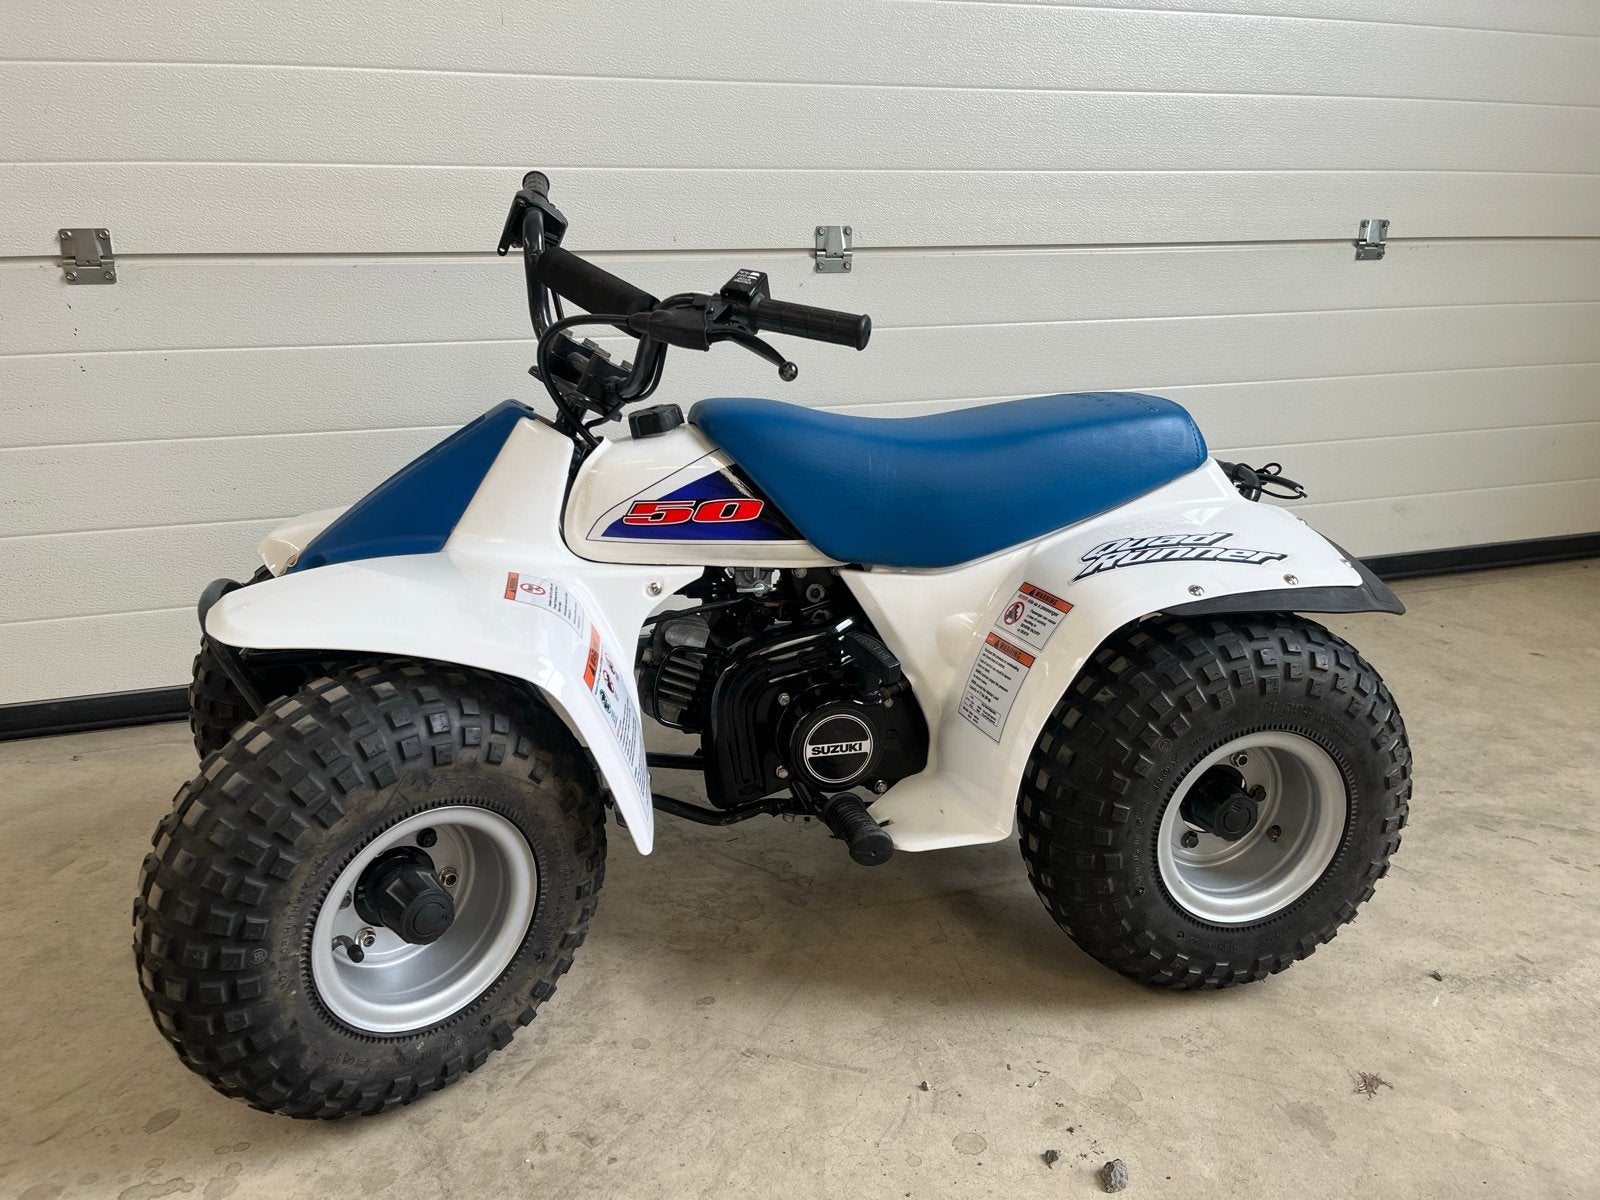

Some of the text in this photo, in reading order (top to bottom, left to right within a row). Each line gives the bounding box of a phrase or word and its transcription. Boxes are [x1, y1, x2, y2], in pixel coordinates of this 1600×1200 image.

[623, 498, 765, 526] 50
[1081, 532, 1234, 562] Quad
[1071, 546, 1288, 583] Runner
[1034, 590, 1059, 607] WARNING
[999, 641, 1022, 660] WARNING
[811, 742, 863, 756] SUZUKI
